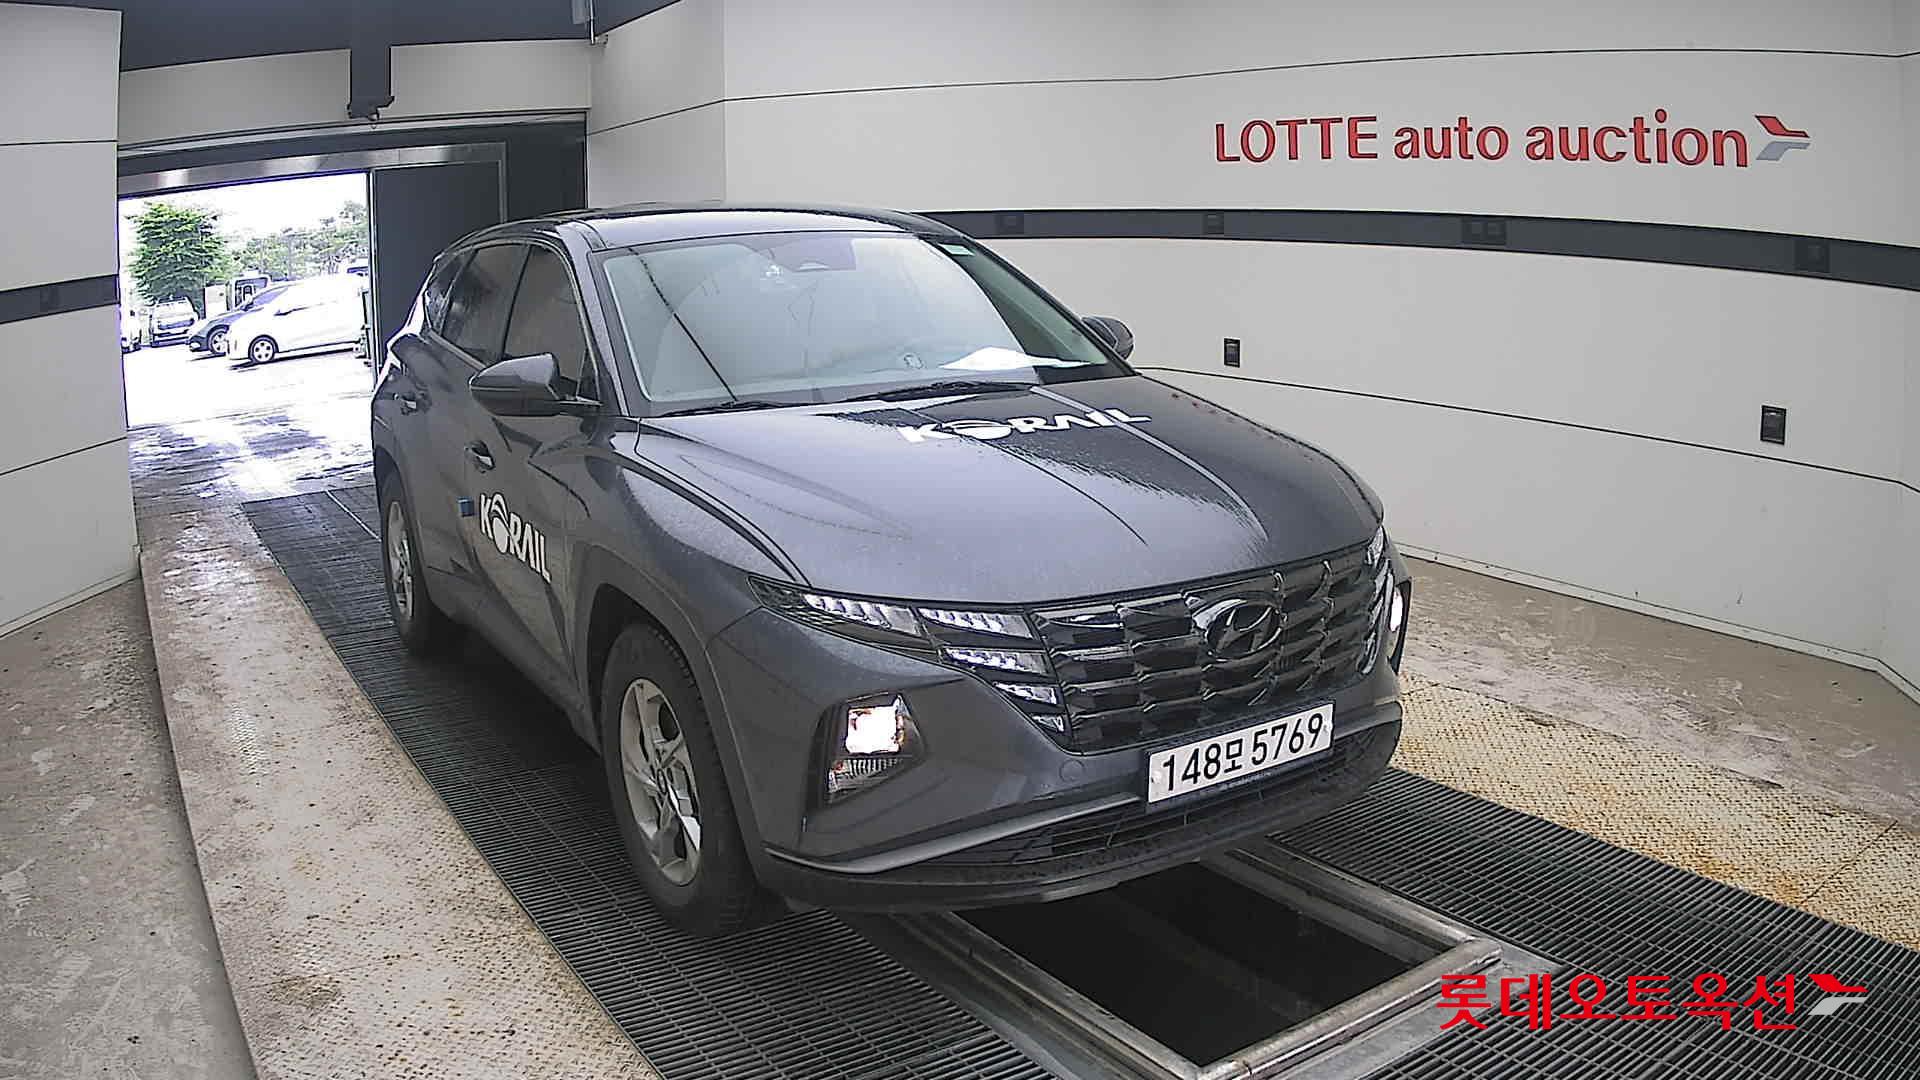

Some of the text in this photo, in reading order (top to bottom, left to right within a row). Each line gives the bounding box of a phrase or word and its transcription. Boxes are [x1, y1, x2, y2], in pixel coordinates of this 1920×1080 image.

[1214, 108, 1749, 168] LOTTE auto auction
[898, 407, 1152, 443] KORAIL
[480, 492, 552, 584] KORAIL
[1162, 712, 1324, 792] 148모 5769
